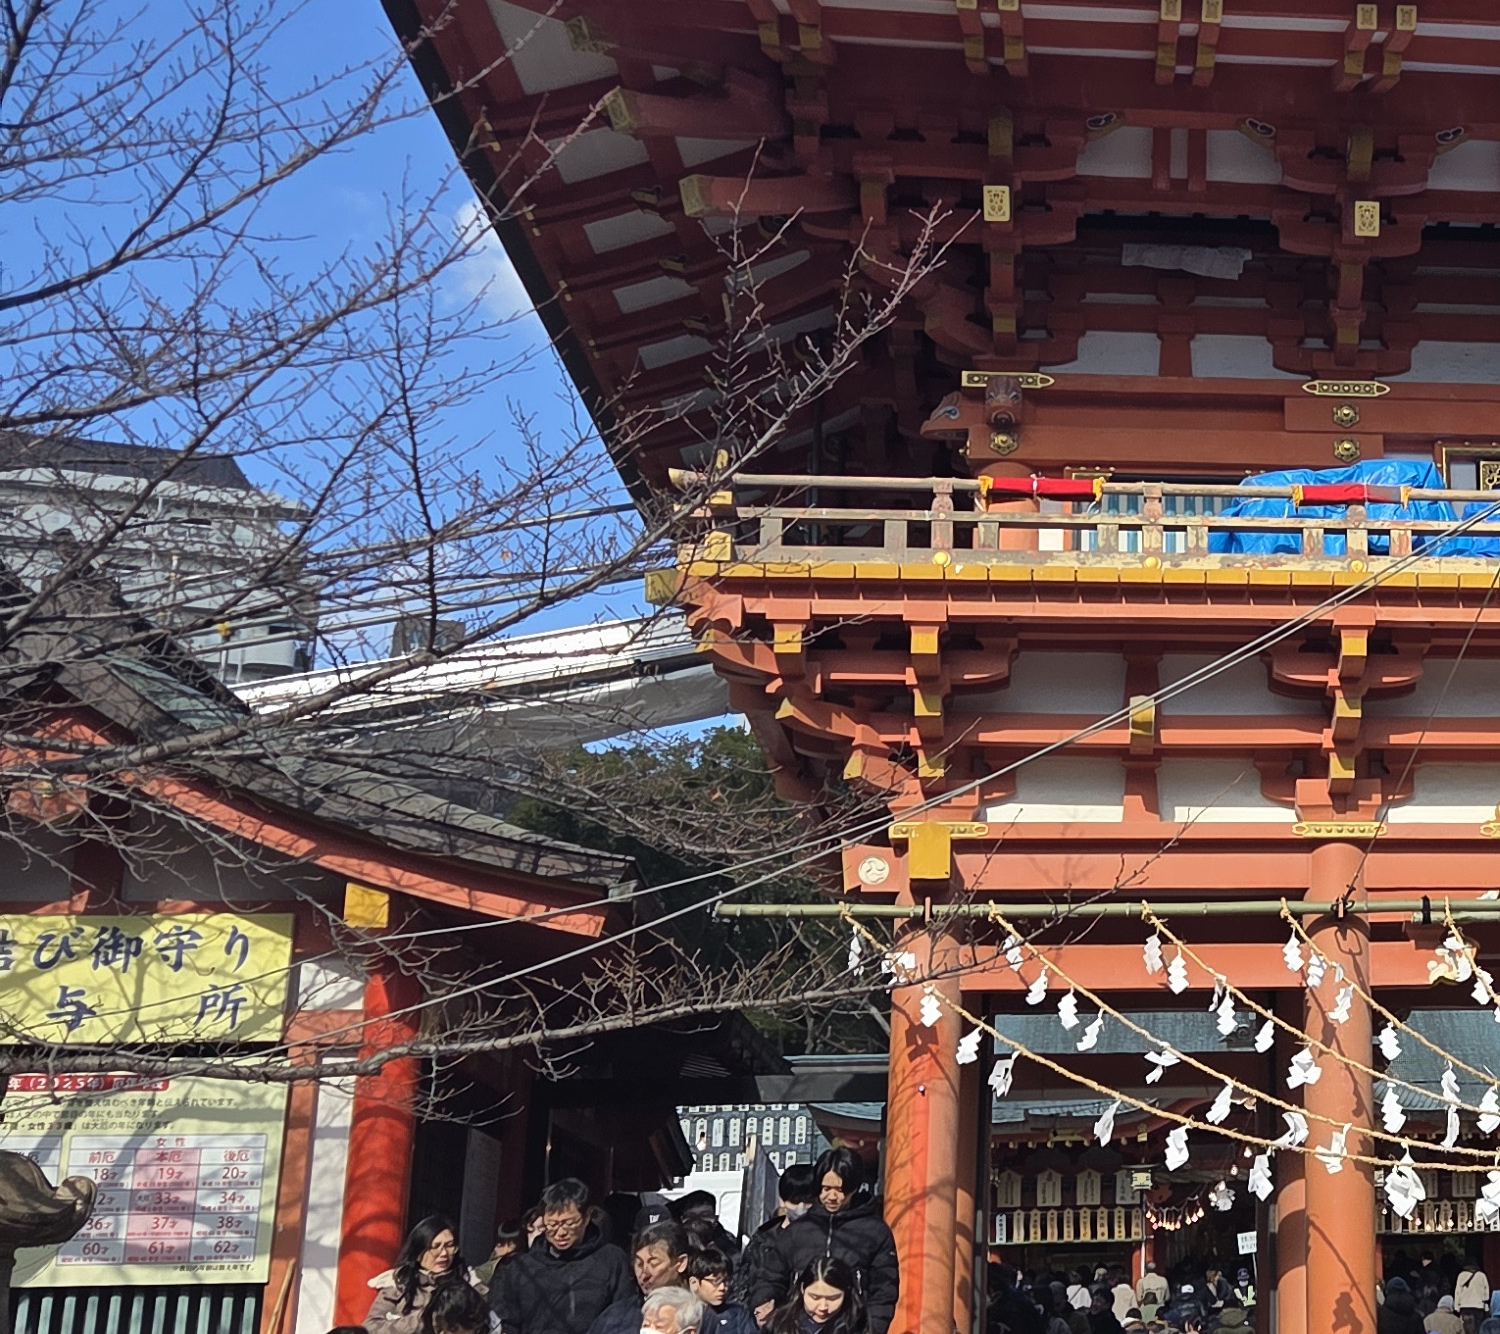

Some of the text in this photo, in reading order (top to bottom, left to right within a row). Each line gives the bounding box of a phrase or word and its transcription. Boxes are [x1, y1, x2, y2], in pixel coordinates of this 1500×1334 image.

[88, 1150, 249, 1163] 前厄 本厄 後厄
